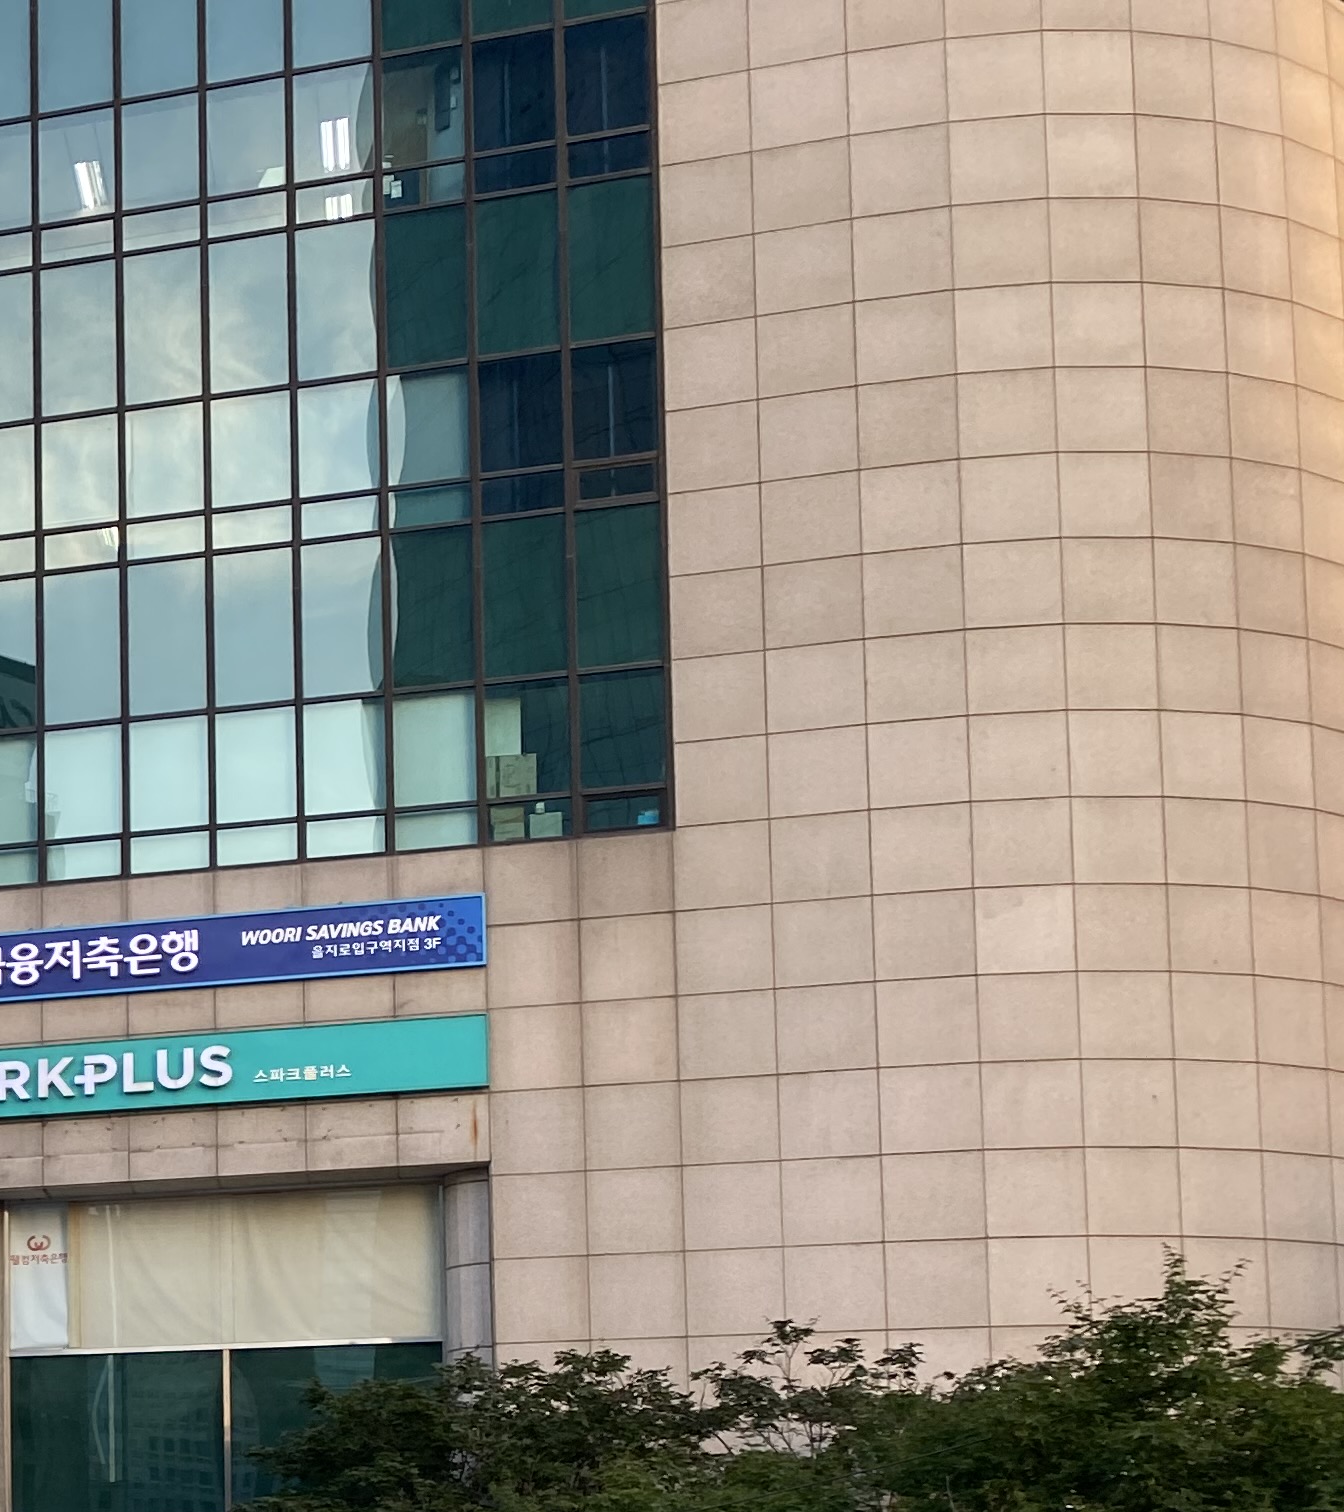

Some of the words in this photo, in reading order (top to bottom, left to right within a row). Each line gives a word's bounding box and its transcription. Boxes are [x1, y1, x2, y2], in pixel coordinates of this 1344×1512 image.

[241, 926, 302, 946] WOORI
[305, 919, 383, 941] SAVINGS
[387, 914, 442, 935] BANK
[312, 937, 420, 959] 을지로입구역지점
[423, 936, 442, 950] 3F
[252, 1063, 352, 1084] 스파크플러스
